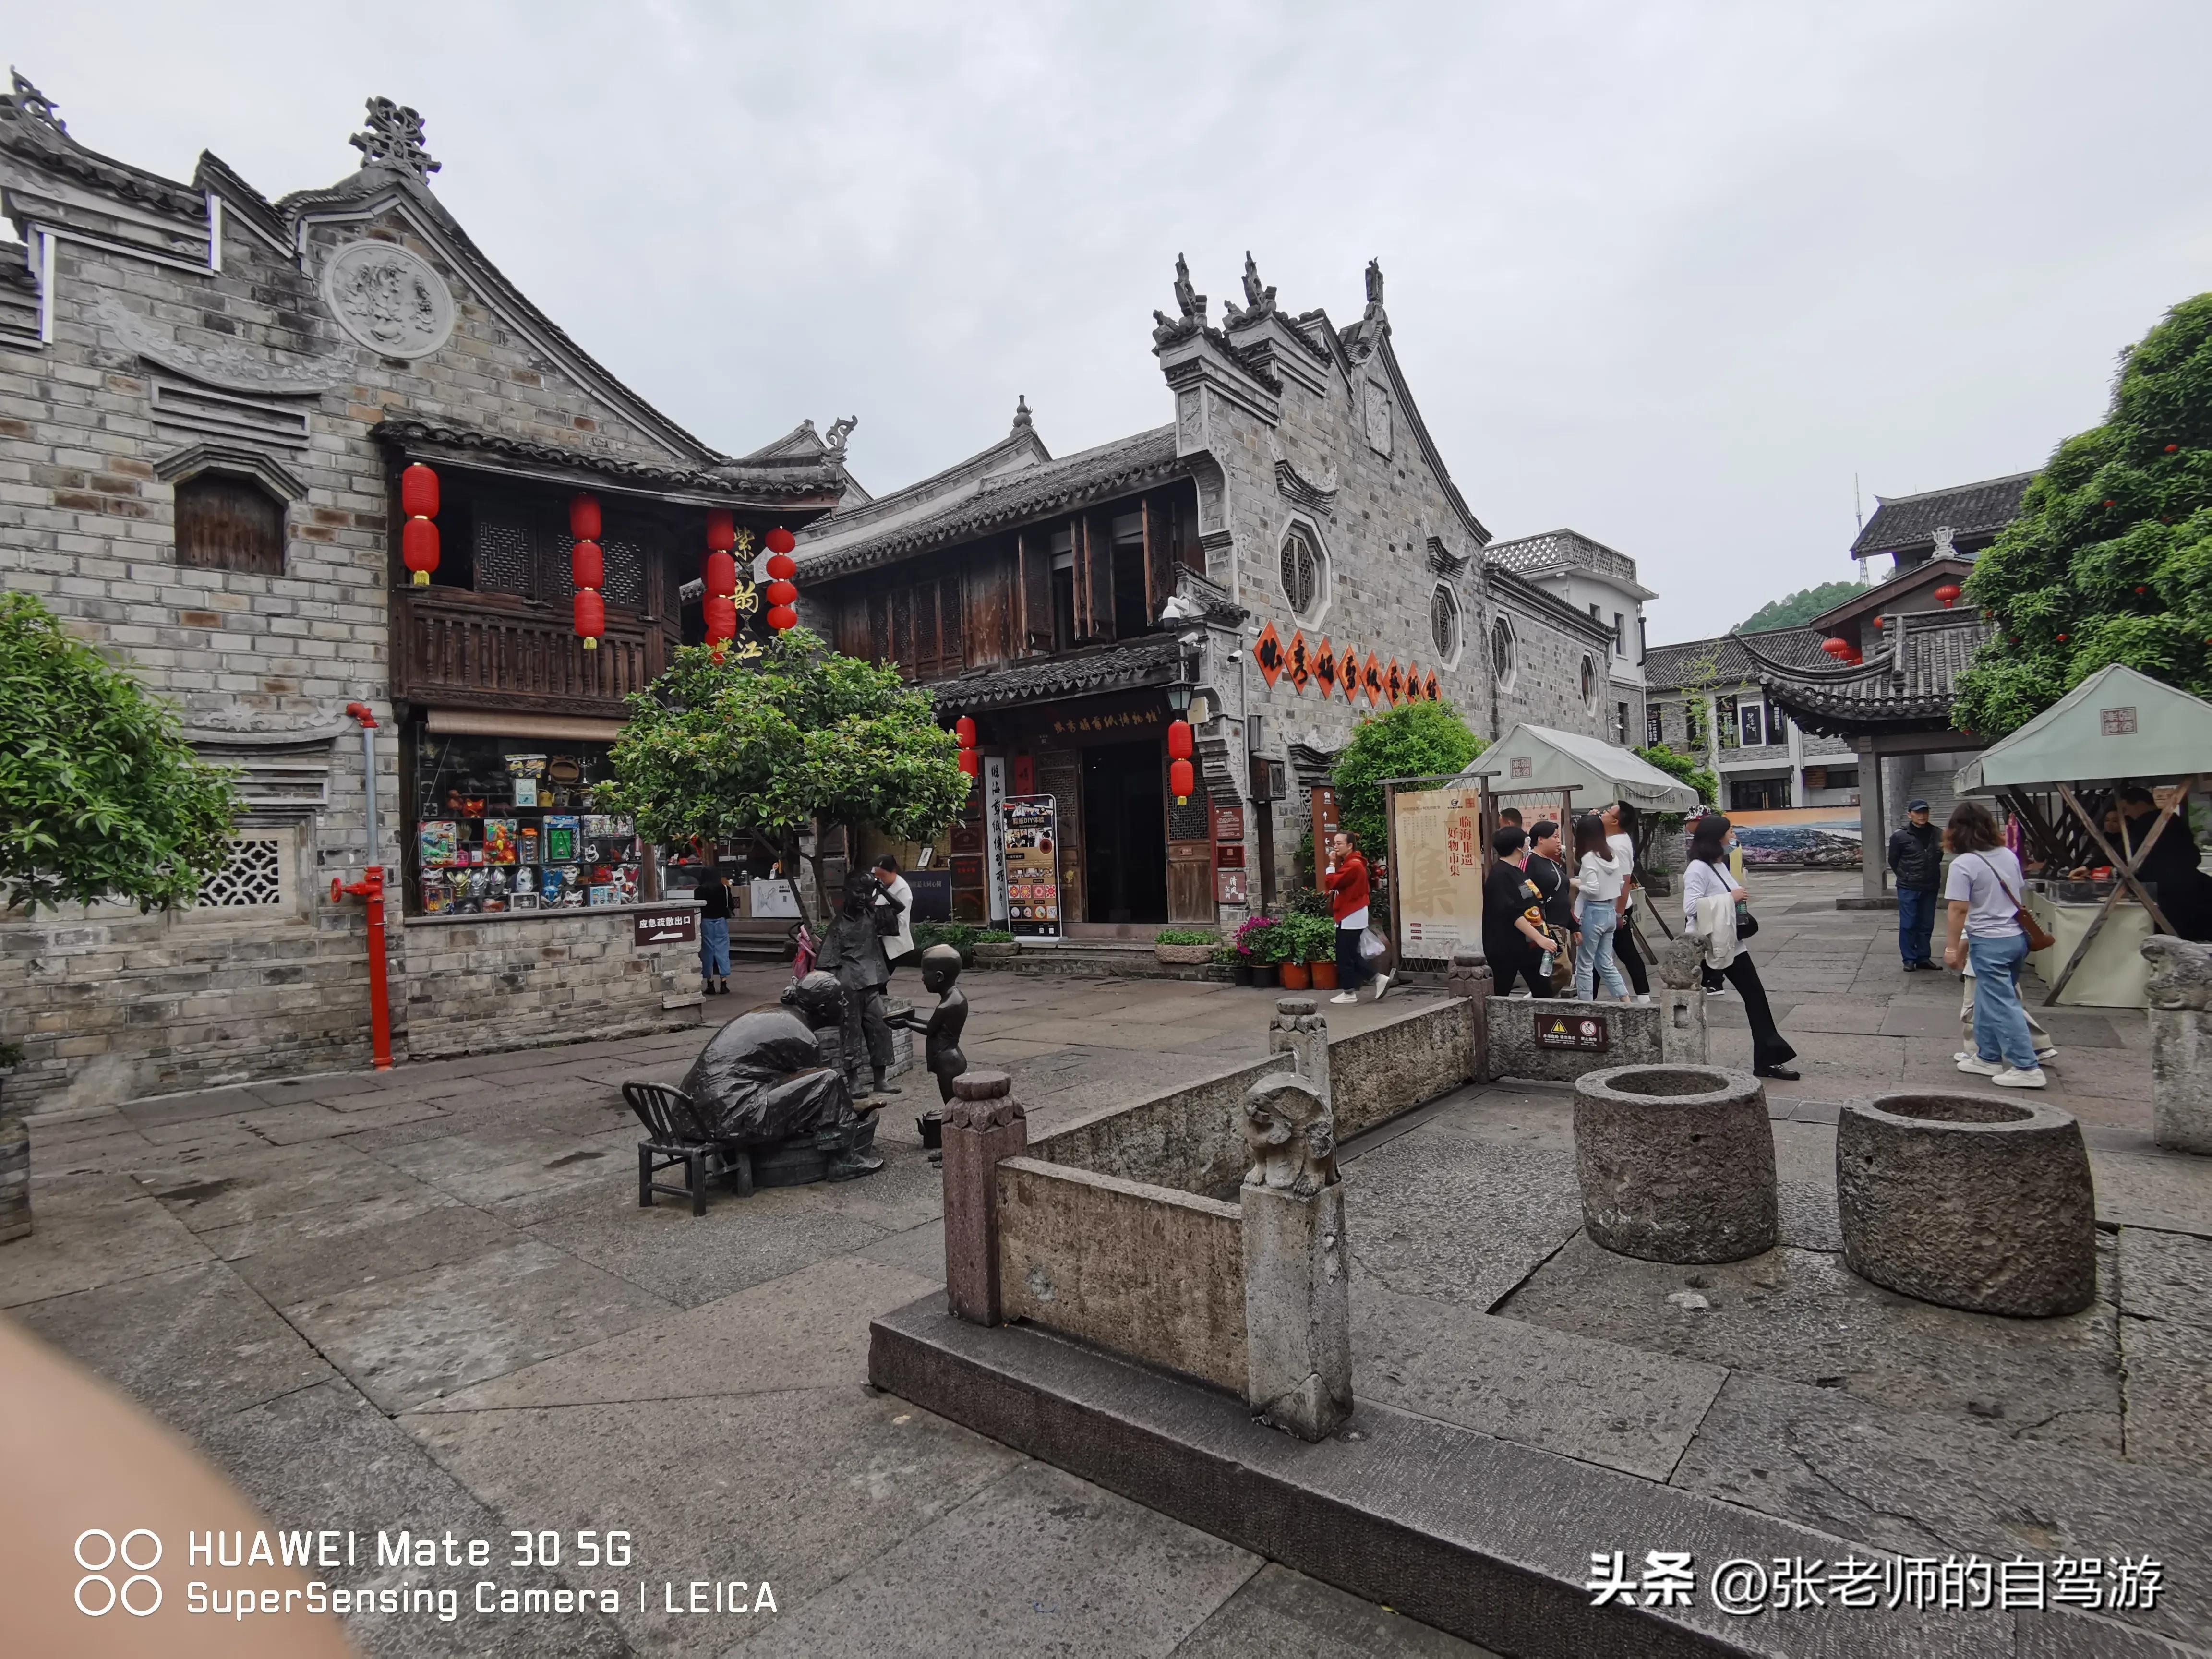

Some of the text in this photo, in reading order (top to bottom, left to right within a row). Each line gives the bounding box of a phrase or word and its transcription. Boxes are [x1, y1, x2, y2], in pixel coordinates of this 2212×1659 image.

[1448, 827, 1460, 877] 好物市集
[1459, 816, 1473, 866] 临海非遗
[639, 916, 691, 929] 应急疏散出口
